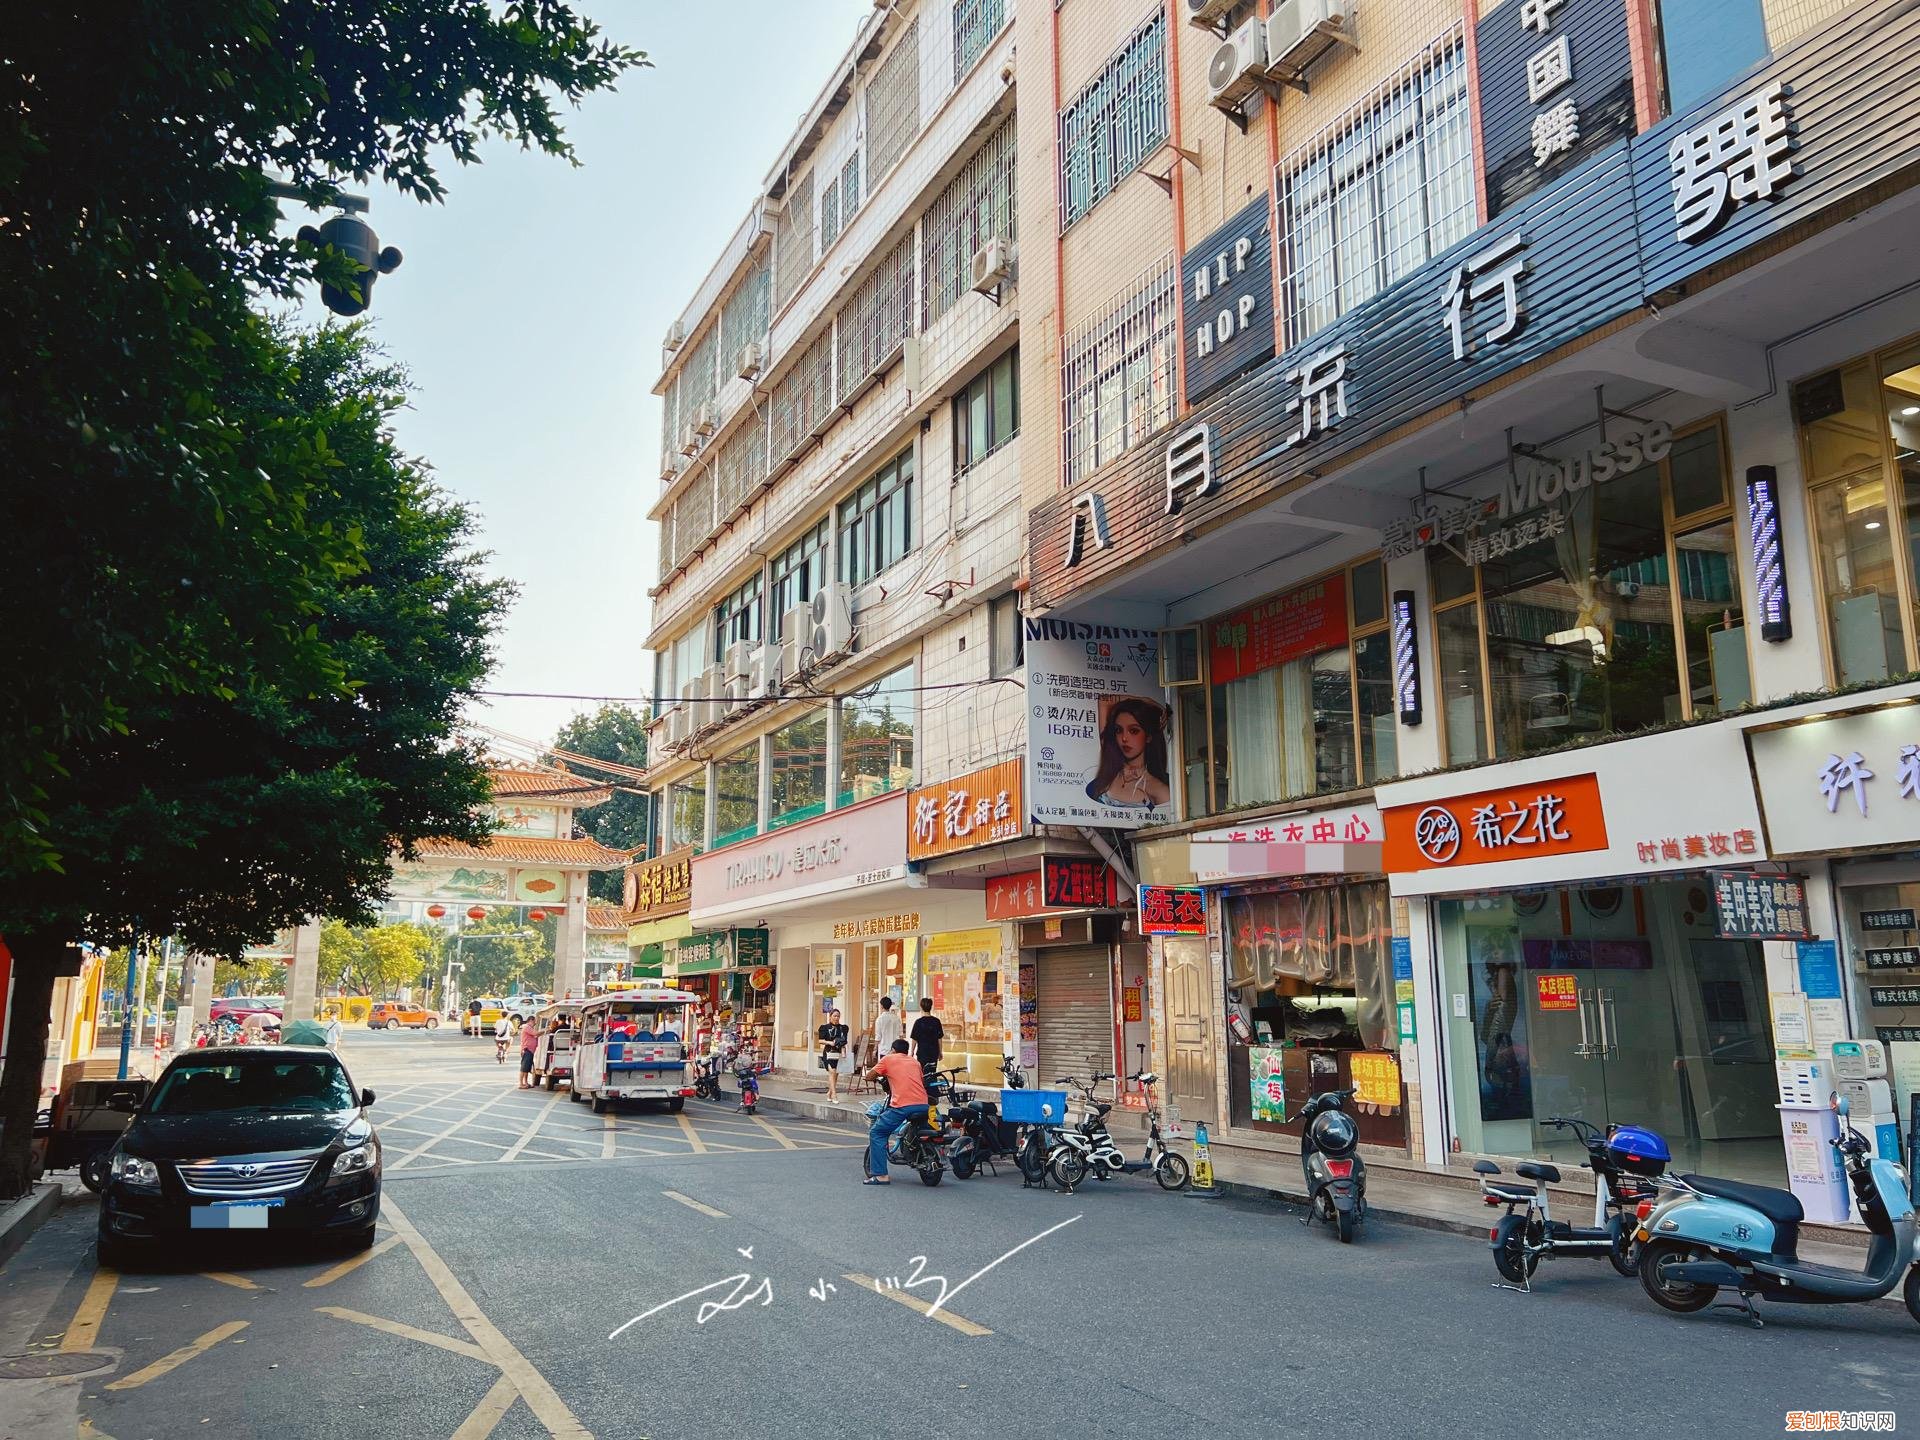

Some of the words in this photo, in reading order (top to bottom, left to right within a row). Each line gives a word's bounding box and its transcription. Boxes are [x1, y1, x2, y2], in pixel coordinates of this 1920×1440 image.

[1520, 0, 1581, 168] 中国舞
[1195, 237, 1252, 302] HIP
[1064, 81, 1801, 569] 八月流行舞
[1197, 294, 1256, 359] HOP
[1499, 420, 1673, 519] Mousse
[1465, 511, 1567, 568] 精致烫染
[1047, 724, 1094, 740] 168元起
[1471, 792, 1572, 849] 希之花
[1636, 827, 1758, 864] 时尚美妆店
[833, 911, 921, 940] 造年轻人喜爱的蛋糕品牌
[1144, 889, 1203, 923] 洗衣
[1125, 988, 1140, 1020] 租房
[1539, 977, 1576, 996] 本店招租
